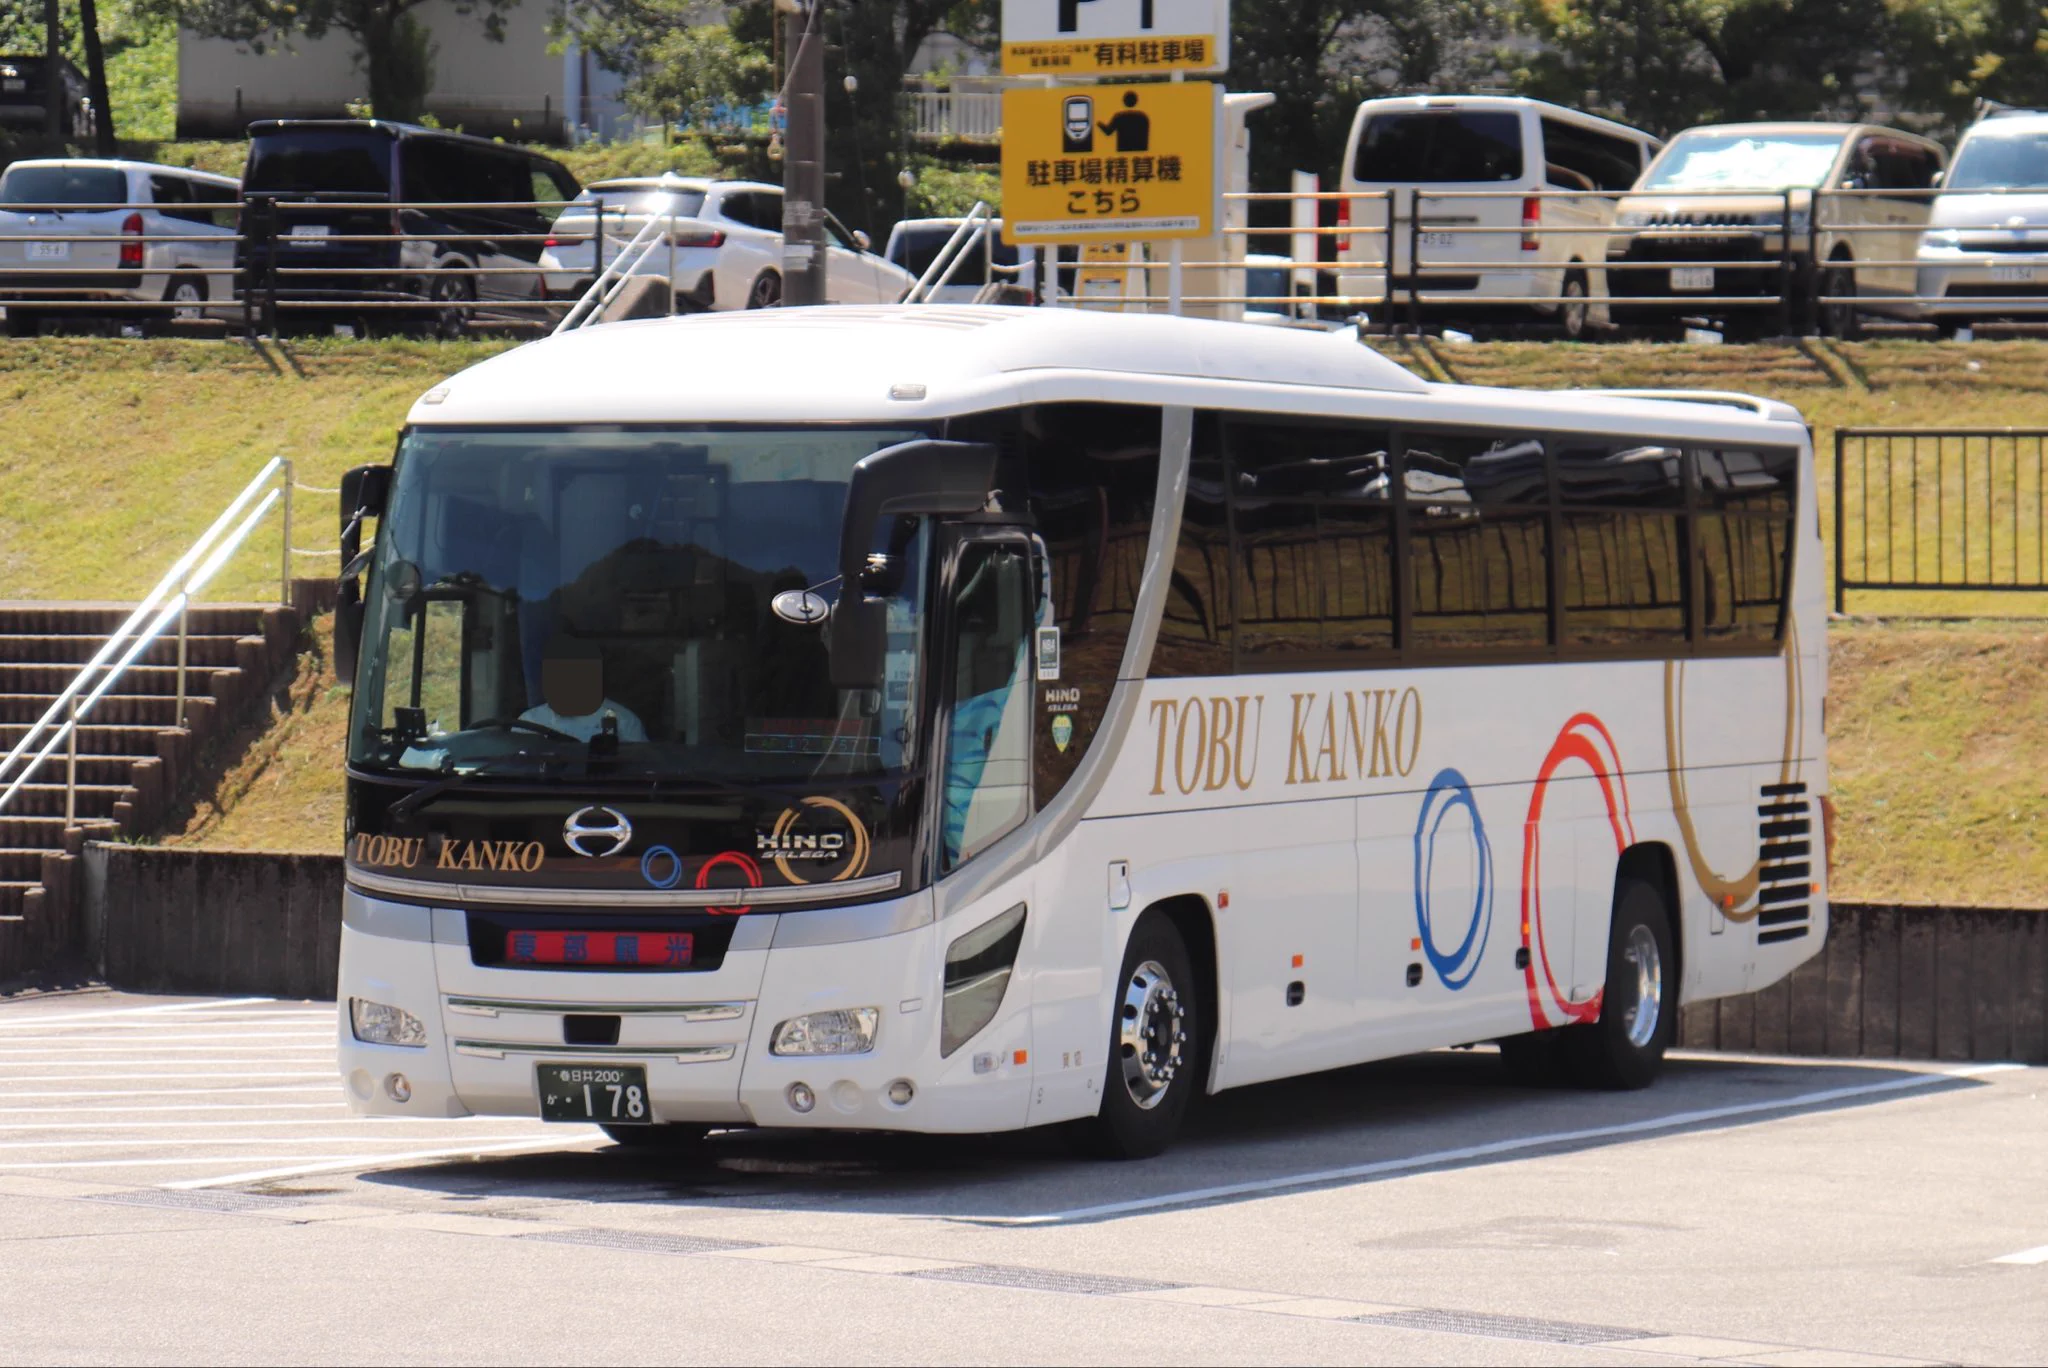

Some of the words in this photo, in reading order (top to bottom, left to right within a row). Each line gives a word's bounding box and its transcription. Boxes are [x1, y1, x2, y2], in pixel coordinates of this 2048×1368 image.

[1094, 39, 1205, 65] 有料駐車場
[1026, 155, 1182, 187] 駐車場精算機
[1067, 188, 1141, 214] こちら
[1045, 687, 1080, 703] HINO
[1149, 694, 1264, 796] TOBU
[1285, 686, 1423, 785] KANKO
[356, 832, 424, 868] TOBU
[436, 839, 545, 872] KANKO
[756, 833, 844, 849] HINO
[760, 849, 839, 859] SELEGA
